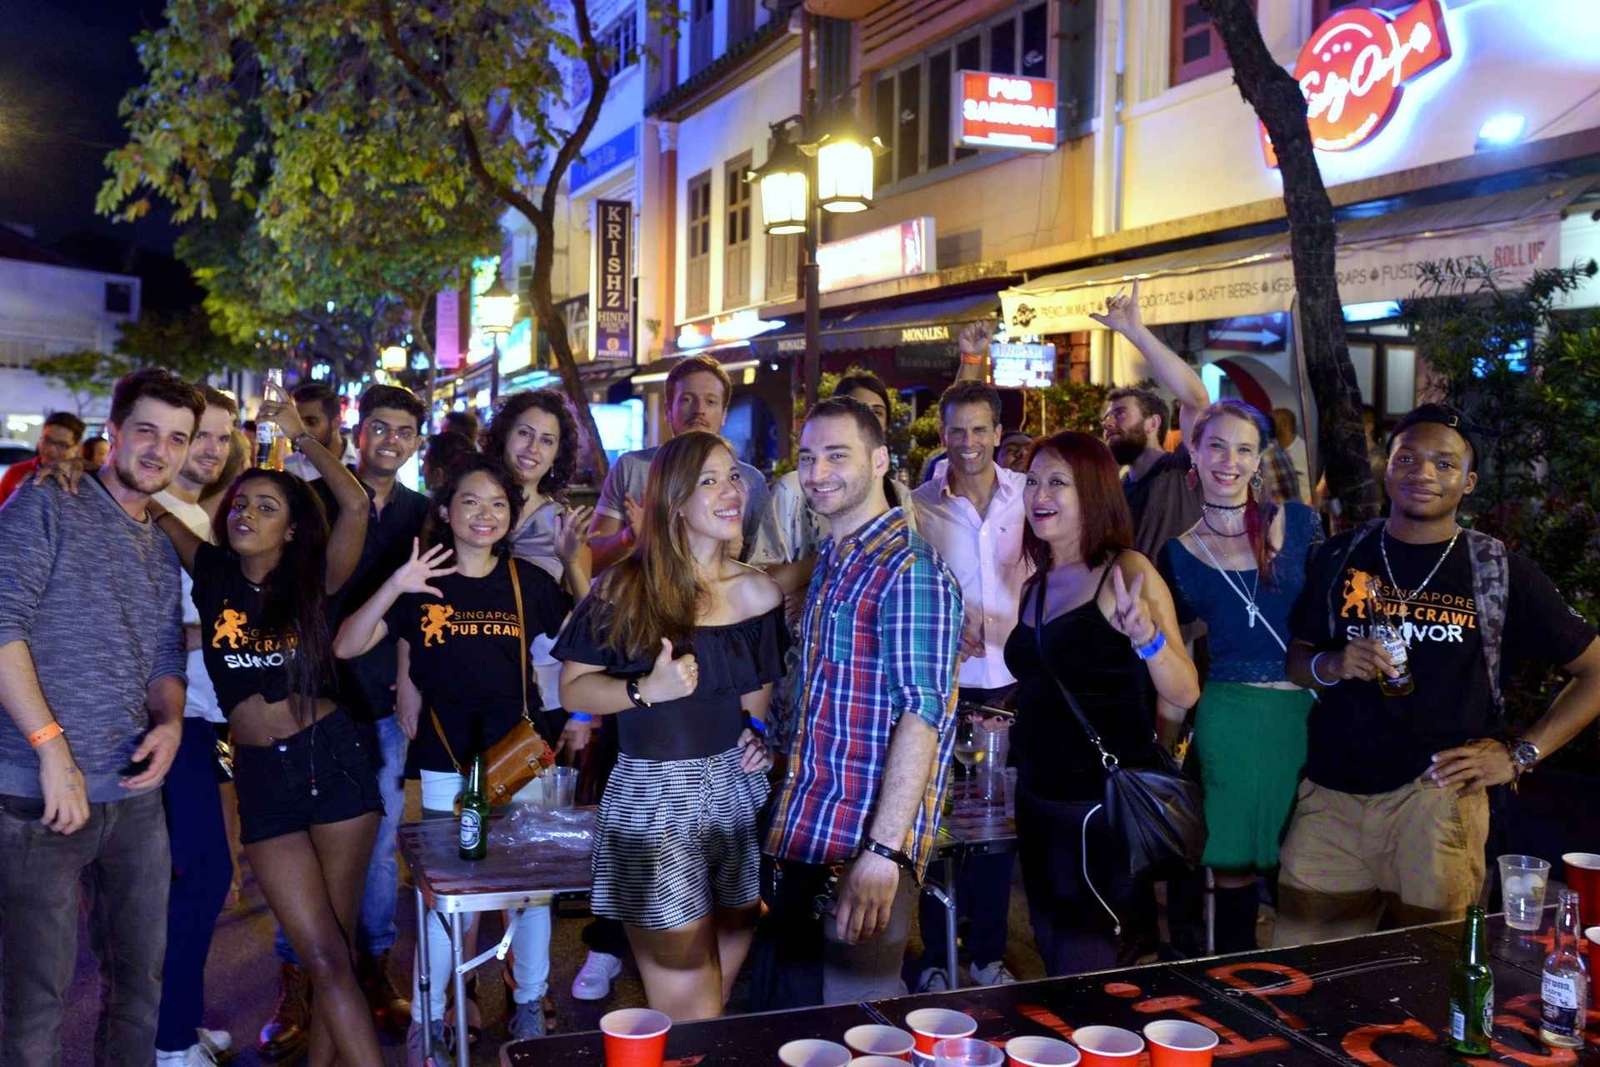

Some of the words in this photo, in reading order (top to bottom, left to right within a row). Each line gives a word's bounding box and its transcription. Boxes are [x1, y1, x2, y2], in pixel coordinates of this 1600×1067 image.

[988, 77, 1032, 101] PUB
[606, 206, 622, 308] KRISHZ
[1494, 244, 1526, 268] ROLL
[1196, 285, 1226, 303] CRAFT
[1228, 281, 1258, 299] BEERS
[1336, 268, 1367, 285] RAPS
[598, 311, 630, 324] HINDI
[778, 338, 807, 351] MONALIS
[902, 326, 949, 342] MONALISA
[1382, 585, 1476, 609] SINGAPORE
[454, 610, 520, 622] SINGAPOR
[1414, 607, 1476, 628] CRAWL
[451, 624, 478, 636] PUB
[483, 624, 522, 638] CRAW
